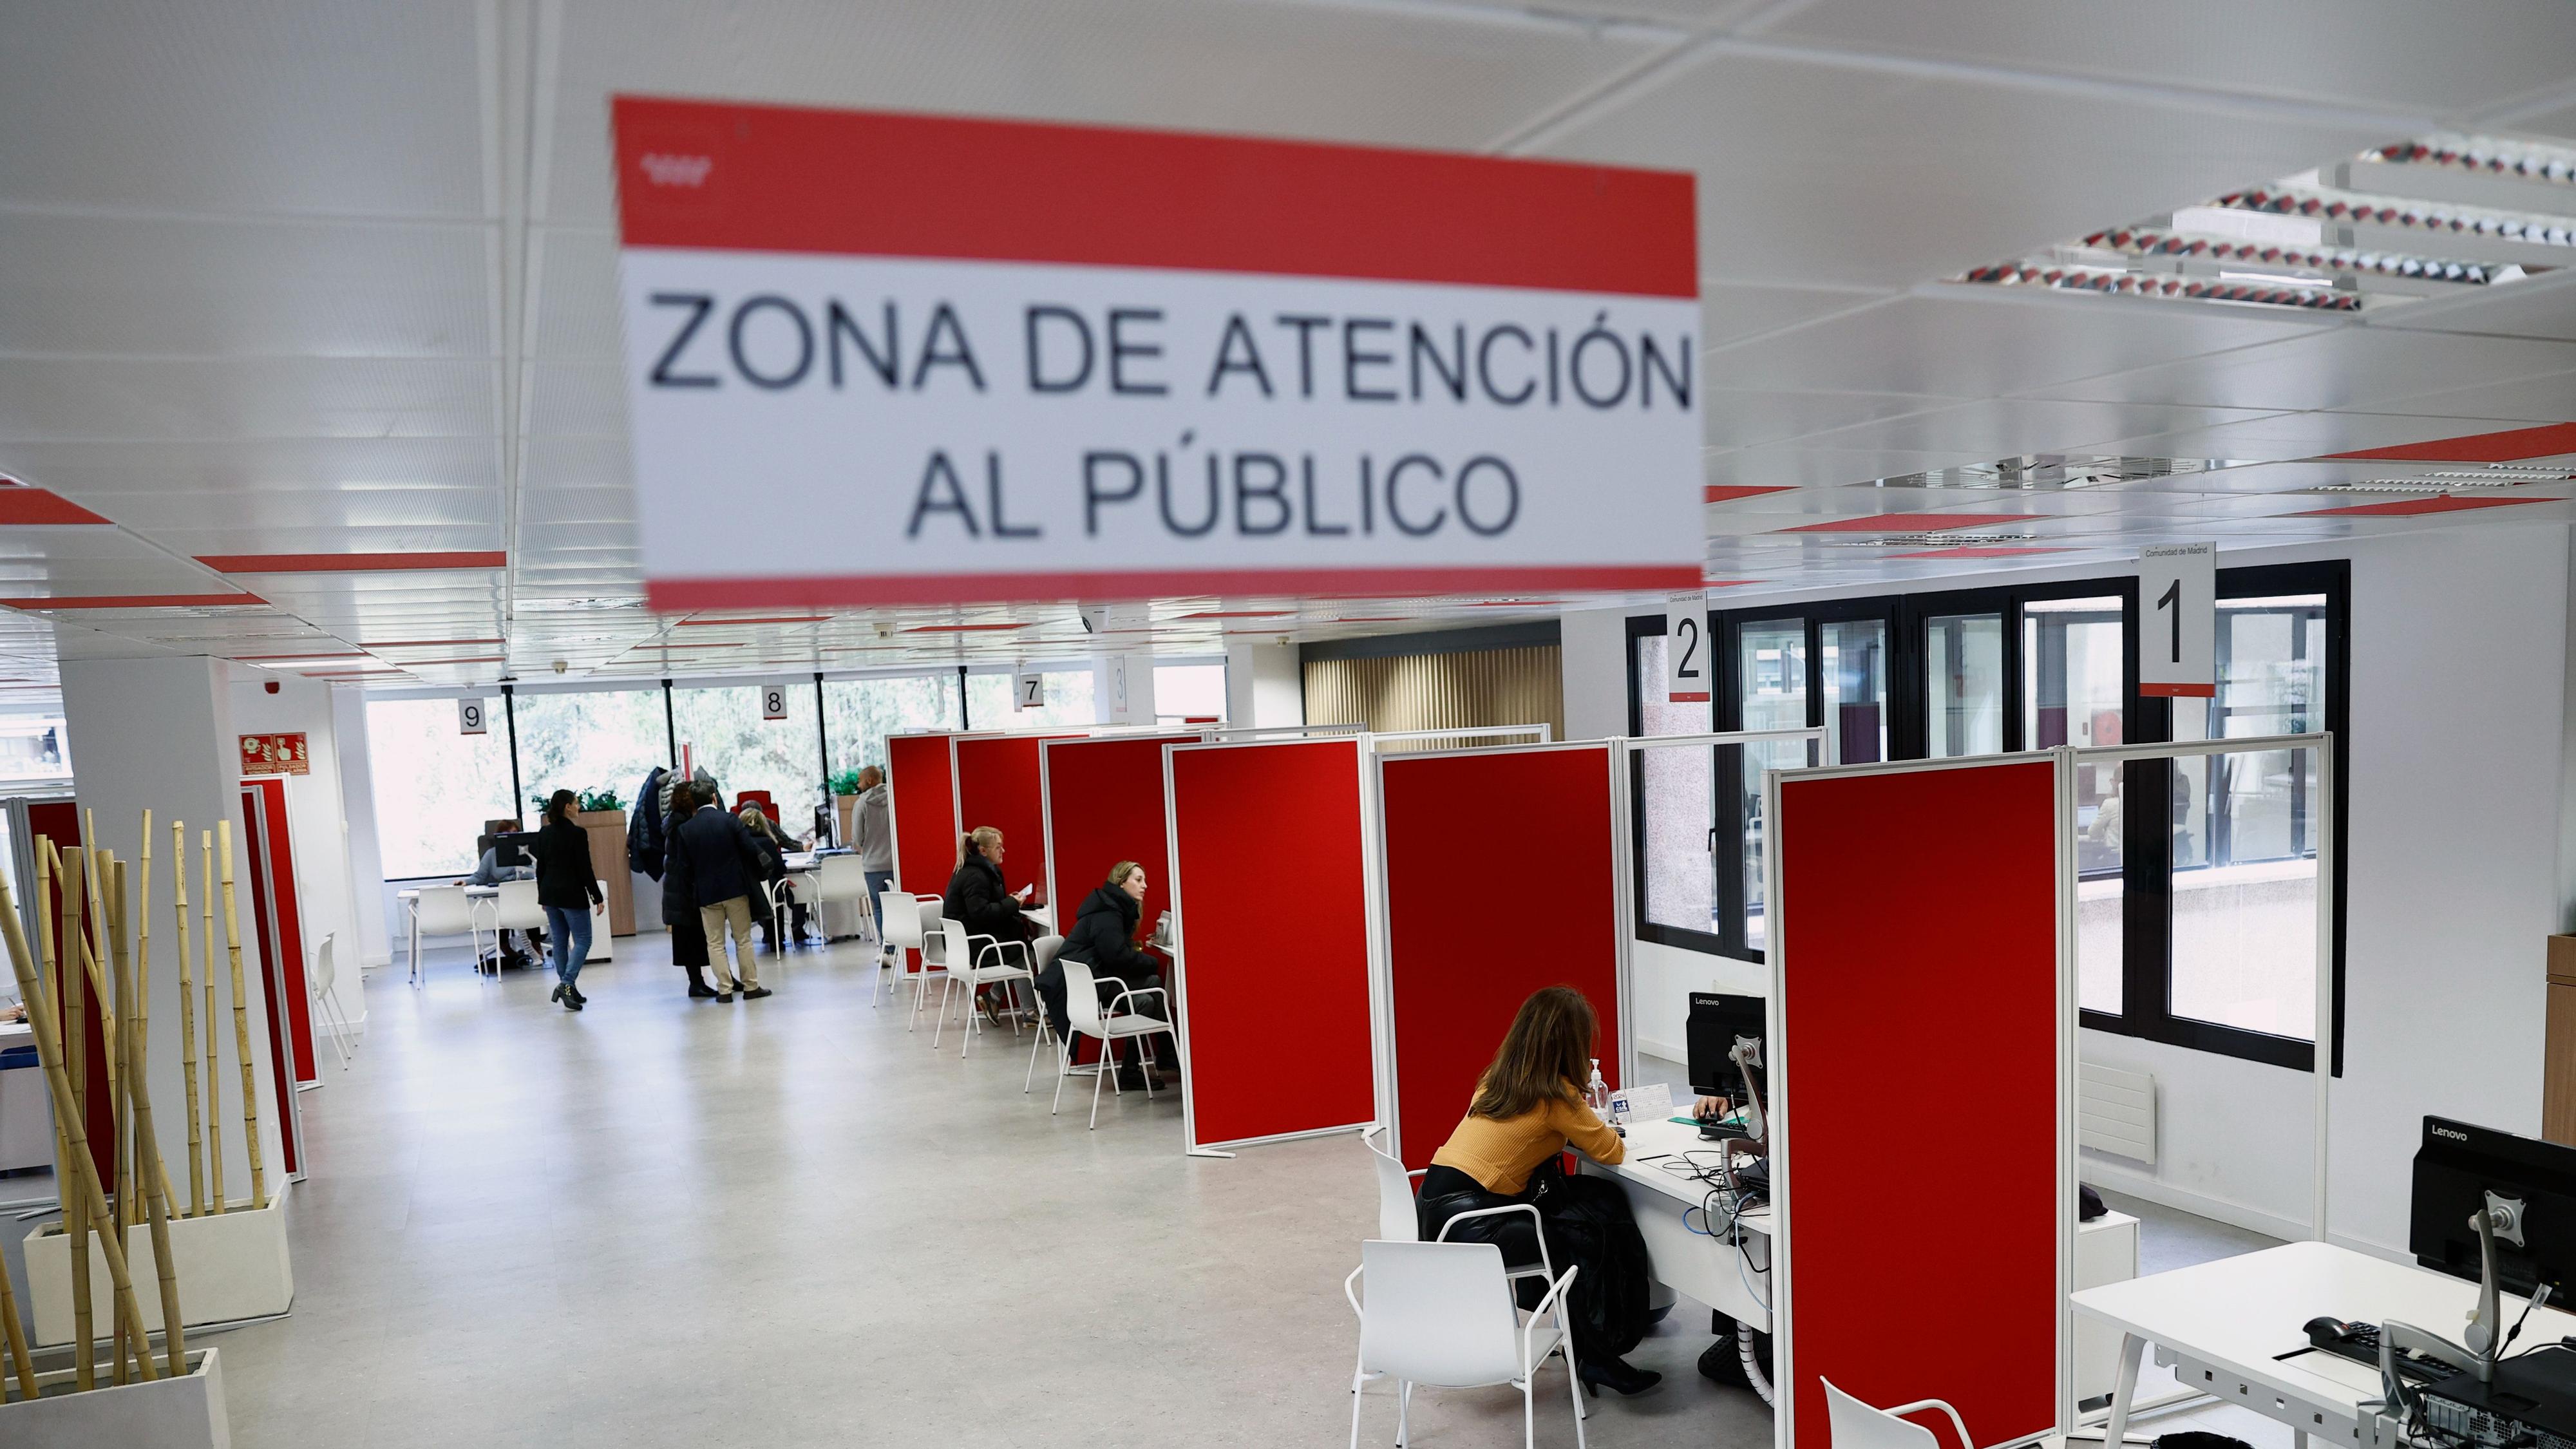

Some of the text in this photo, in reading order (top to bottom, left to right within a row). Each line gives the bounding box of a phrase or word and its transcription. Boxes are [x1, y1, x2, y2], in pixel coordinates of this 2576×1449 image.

[648, 292, 1692, 412] ZONA DE ATENCIÓN
[906, 431, 1522, 539] AL PÚBLICO
[2157, 579, 2180, 663] 1
[1677, 618, 1700, 678] 2
[1025, 681, 1037, 700] 7
[1117, 668, 1123, 699] 3
[768, 692, 781, 712] 8
[465, 706, 479, 727] 9
[1695, 997, 1719, 1006] Lenovo
[2432, 1124, 2467, 1141] Lenovo
